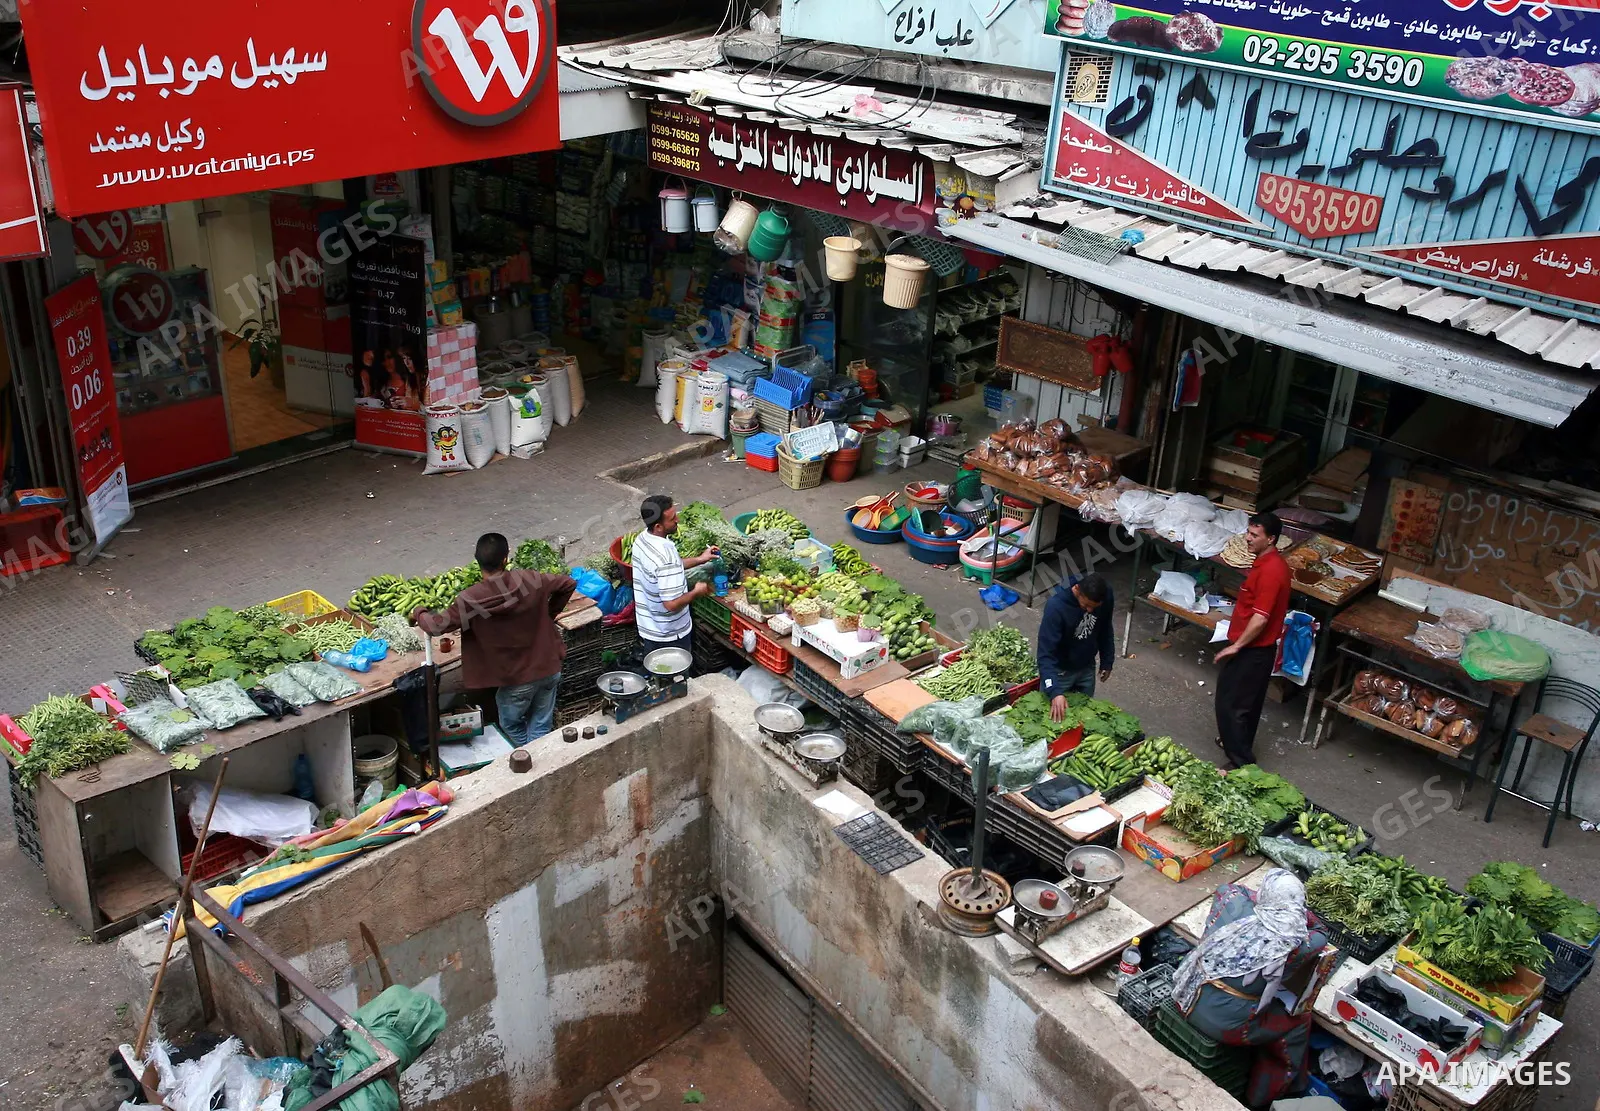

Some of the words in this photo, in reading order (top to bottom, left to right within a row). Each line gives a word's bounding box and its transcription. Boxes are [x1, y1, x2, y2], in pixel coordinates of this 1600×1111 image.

[1321, 7, 1351, 25] قمح
[1351, 14, 1390, 31] طابون
[935, 19, 975, 54] علب
[1439, 24, 1482, 43] طابون
[79, 44, 224, 102] موبايل
[229, 36, 327, 89] سهيل
[1243, 35, 1340, 74] 02-295
[1347, 50, 1425, 87] 3590
[89, 124, 150, 154] معتمد
[155, 119, 206, 152] وكيل
[651, 123, 700, 143] 0599-765629
[651, 137, 700, 157] 0599-663617
[1063, 128, 1112, 154] صفيحة
[96, 147, 315, 189] www.wataniya.ps
[652, 151, 700, 172] 0599-396873
[771, 135, 832, 186] للادوات
[835, 151, 924, 207] السلوادي
[1114, 175, 1150, 197] زيت
[1152, 181, 1206, 206] مناقيش
[1260, 176, 1378, 235] 9953590
[1415, 247, 1460, 269] بيض
[1460, 257, 1520, 280] اقراص
[1532, 248, 1593, 278] قرشلة
[67, 326, 91, 358] 0.39
